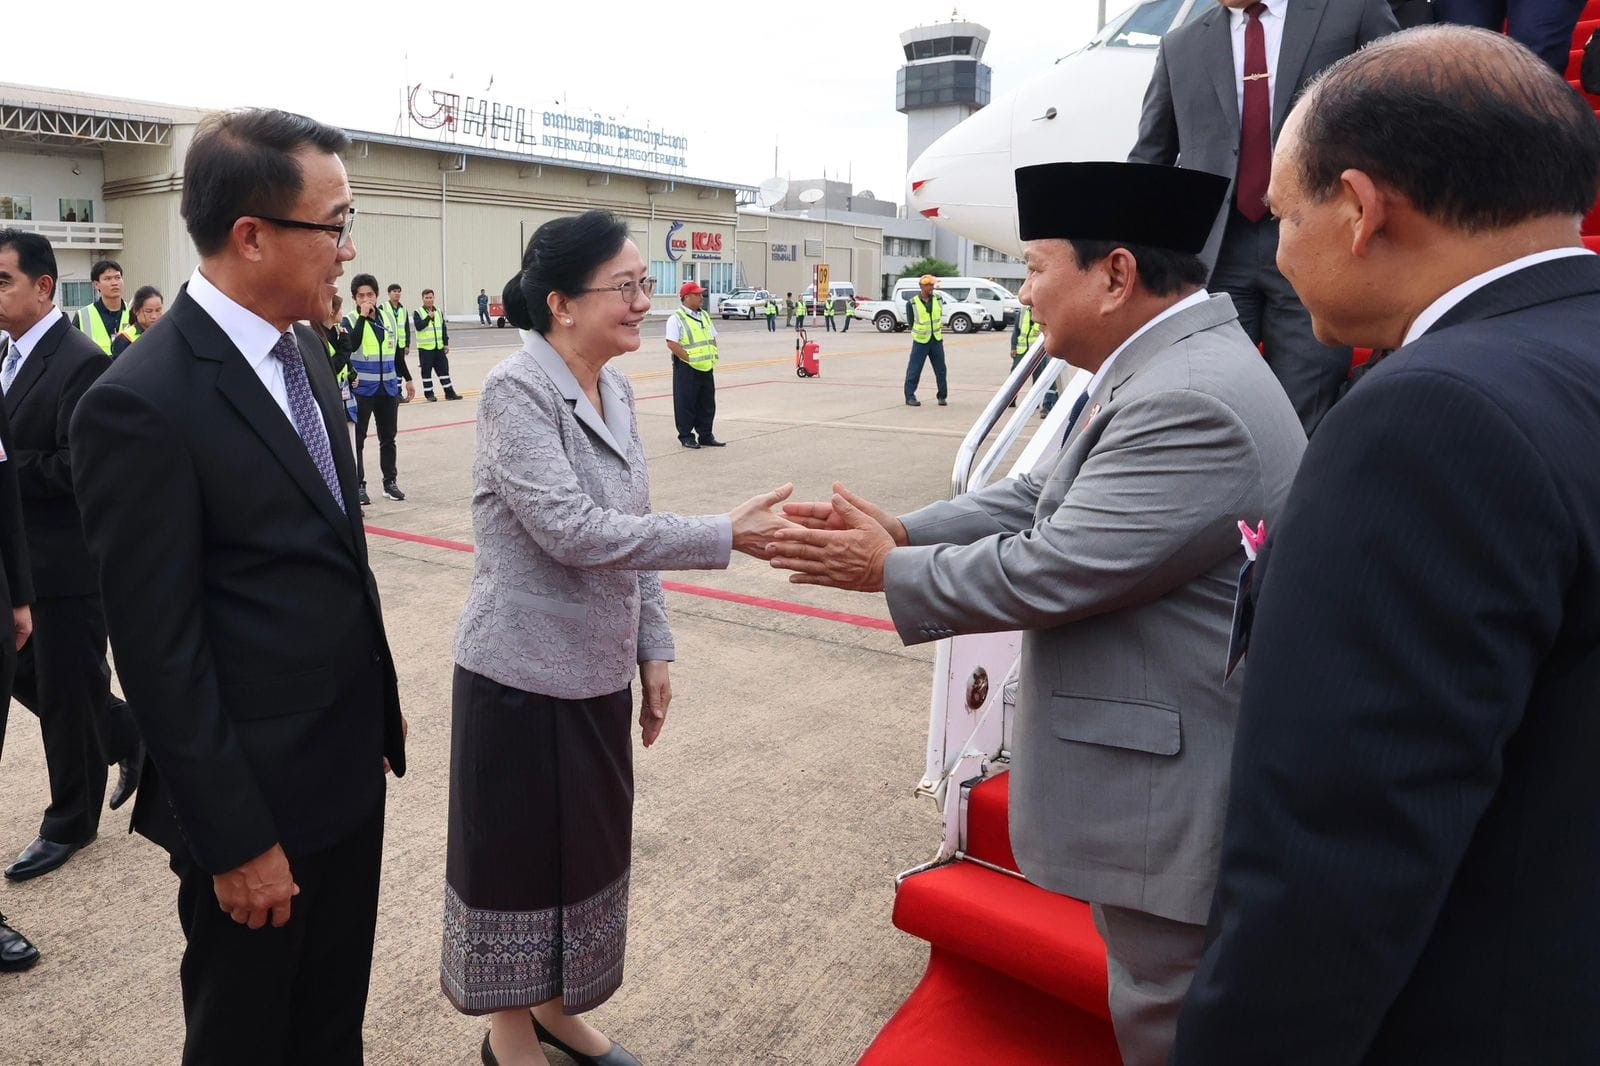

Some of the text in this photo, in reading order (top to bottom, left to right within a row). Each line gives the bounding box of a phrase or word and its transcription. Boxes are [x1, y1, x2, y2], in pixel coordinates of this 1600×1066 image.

[543, 134, 687, 167] INTERNATIONAL CARGO TERMINAL
[691, 232, 722, 251] KCAS
